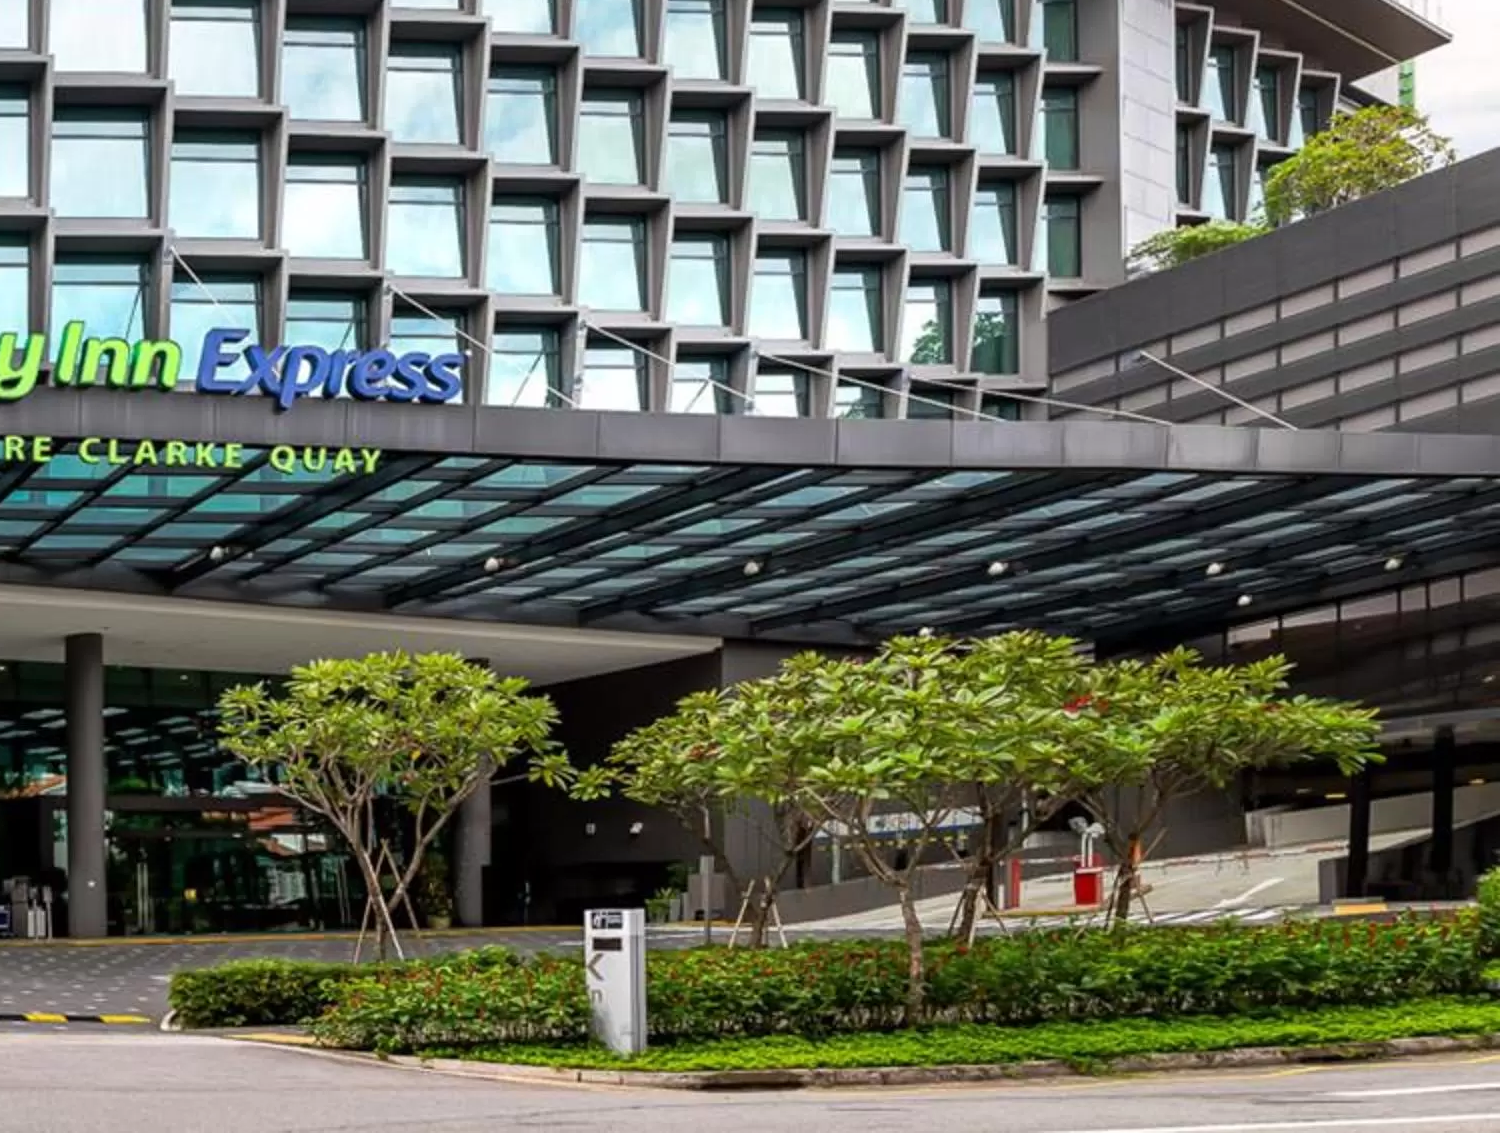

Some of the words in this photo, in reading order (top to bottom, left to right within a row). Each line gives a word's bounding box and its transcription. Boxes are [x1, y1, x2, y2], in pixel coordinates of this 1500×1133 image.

[196, 327, 465, 412] Express
[77, 437, 243, 469] CLARKE
[269, 444, 382, 475] QUAY
